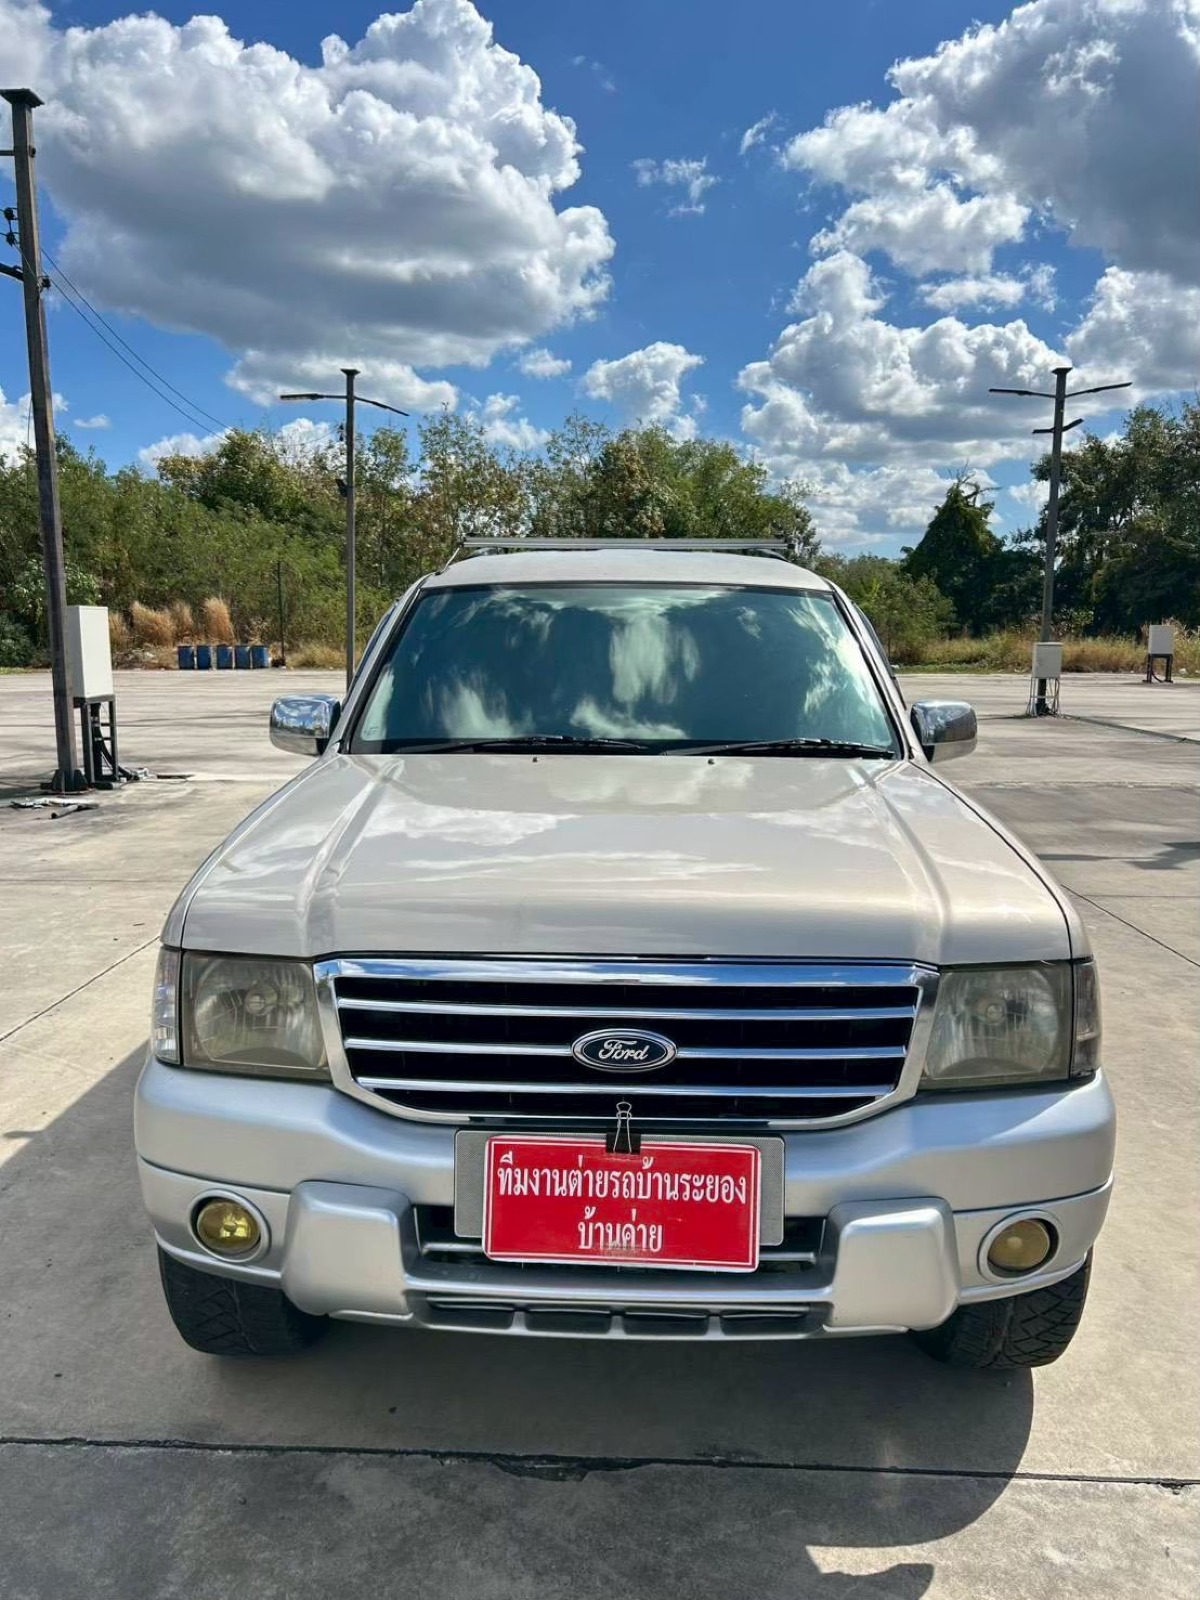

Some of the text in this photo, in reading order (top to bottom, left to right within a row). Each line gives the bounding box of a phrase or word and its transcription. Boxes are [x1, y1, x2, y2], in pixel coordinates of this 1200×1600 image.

[598, 1039, 650, 1060] Ford
[497, 1150, 746, 1204] ทีมงานต่ายรถบ้านระยอง
[577, 1205, 662, 1252] บ้านค่าย
